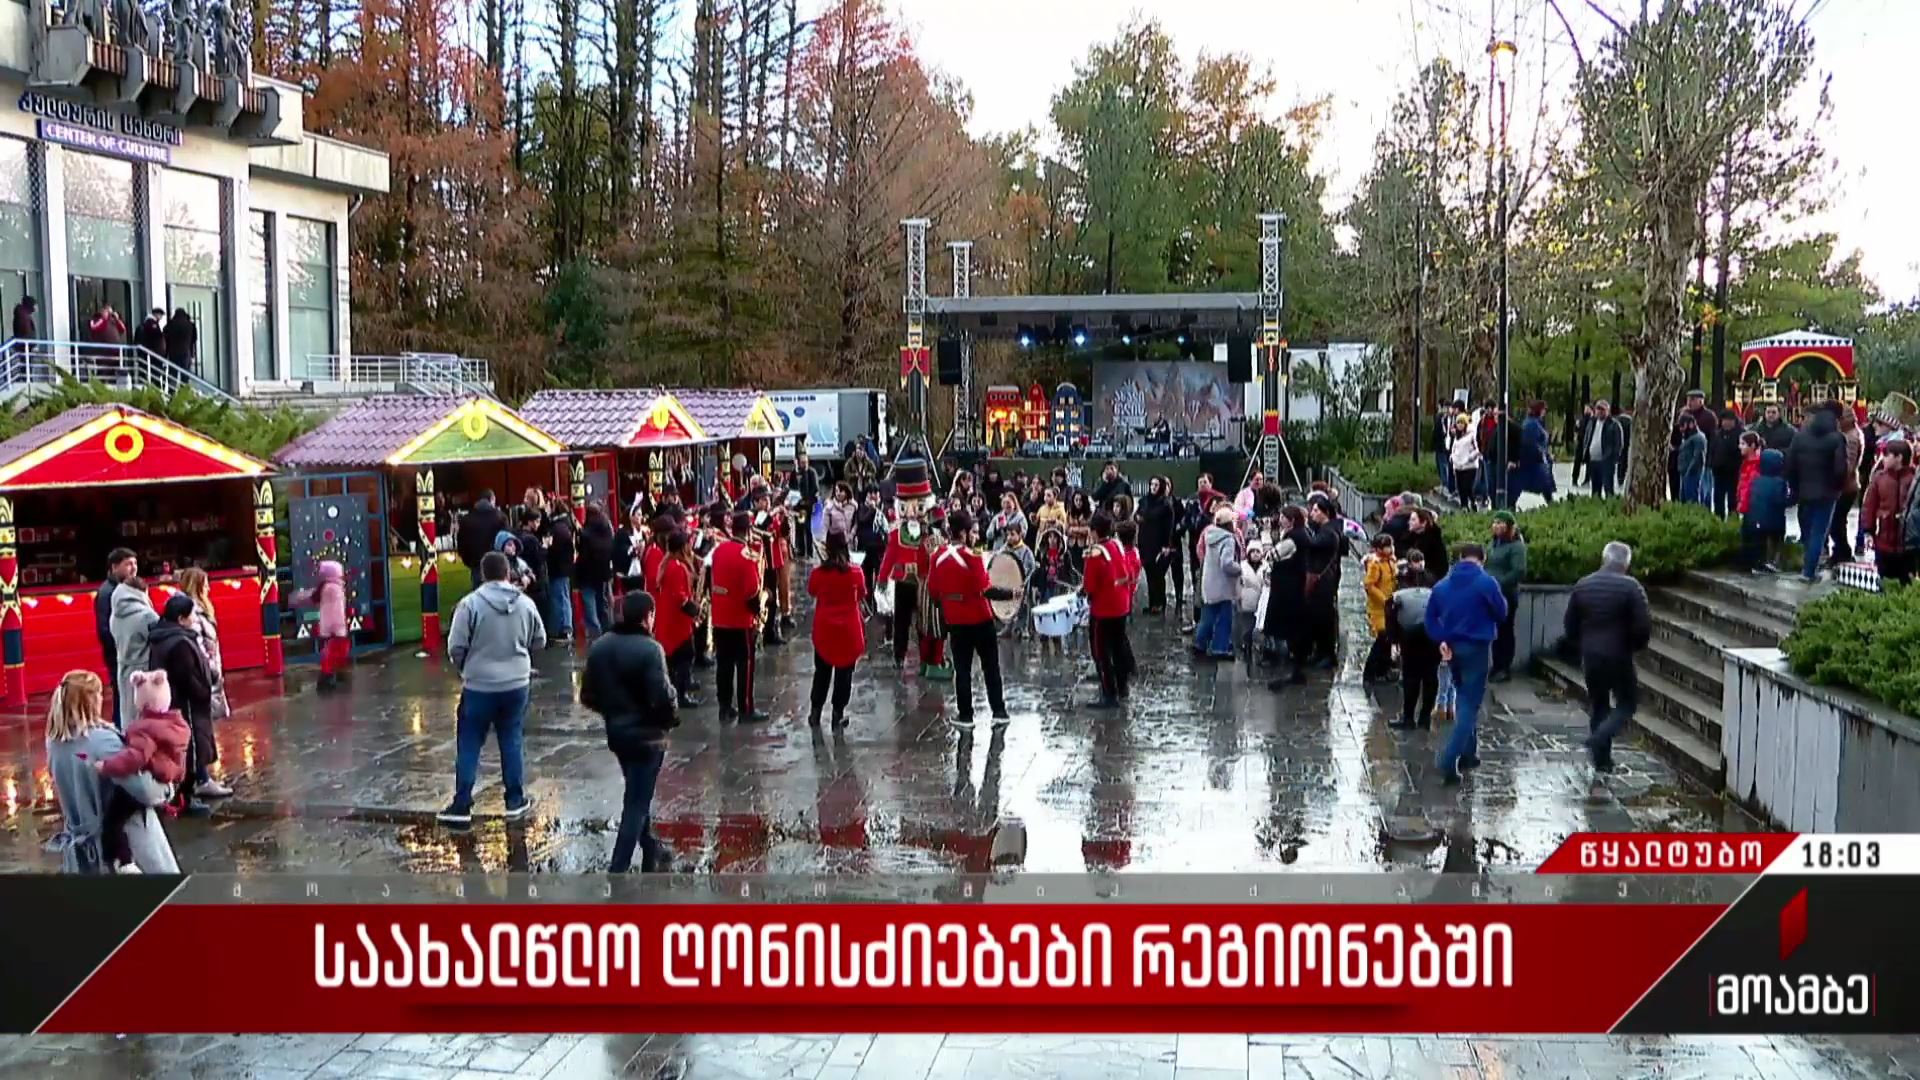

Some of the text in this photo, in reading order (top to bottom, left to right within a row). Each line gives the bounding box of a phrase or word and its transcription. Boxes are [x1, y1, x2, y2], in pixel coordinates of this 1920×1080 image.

[46, 124, 169, 162] CENTER OF CULTURE
[121, 112, 183, 146] ცენტრი
